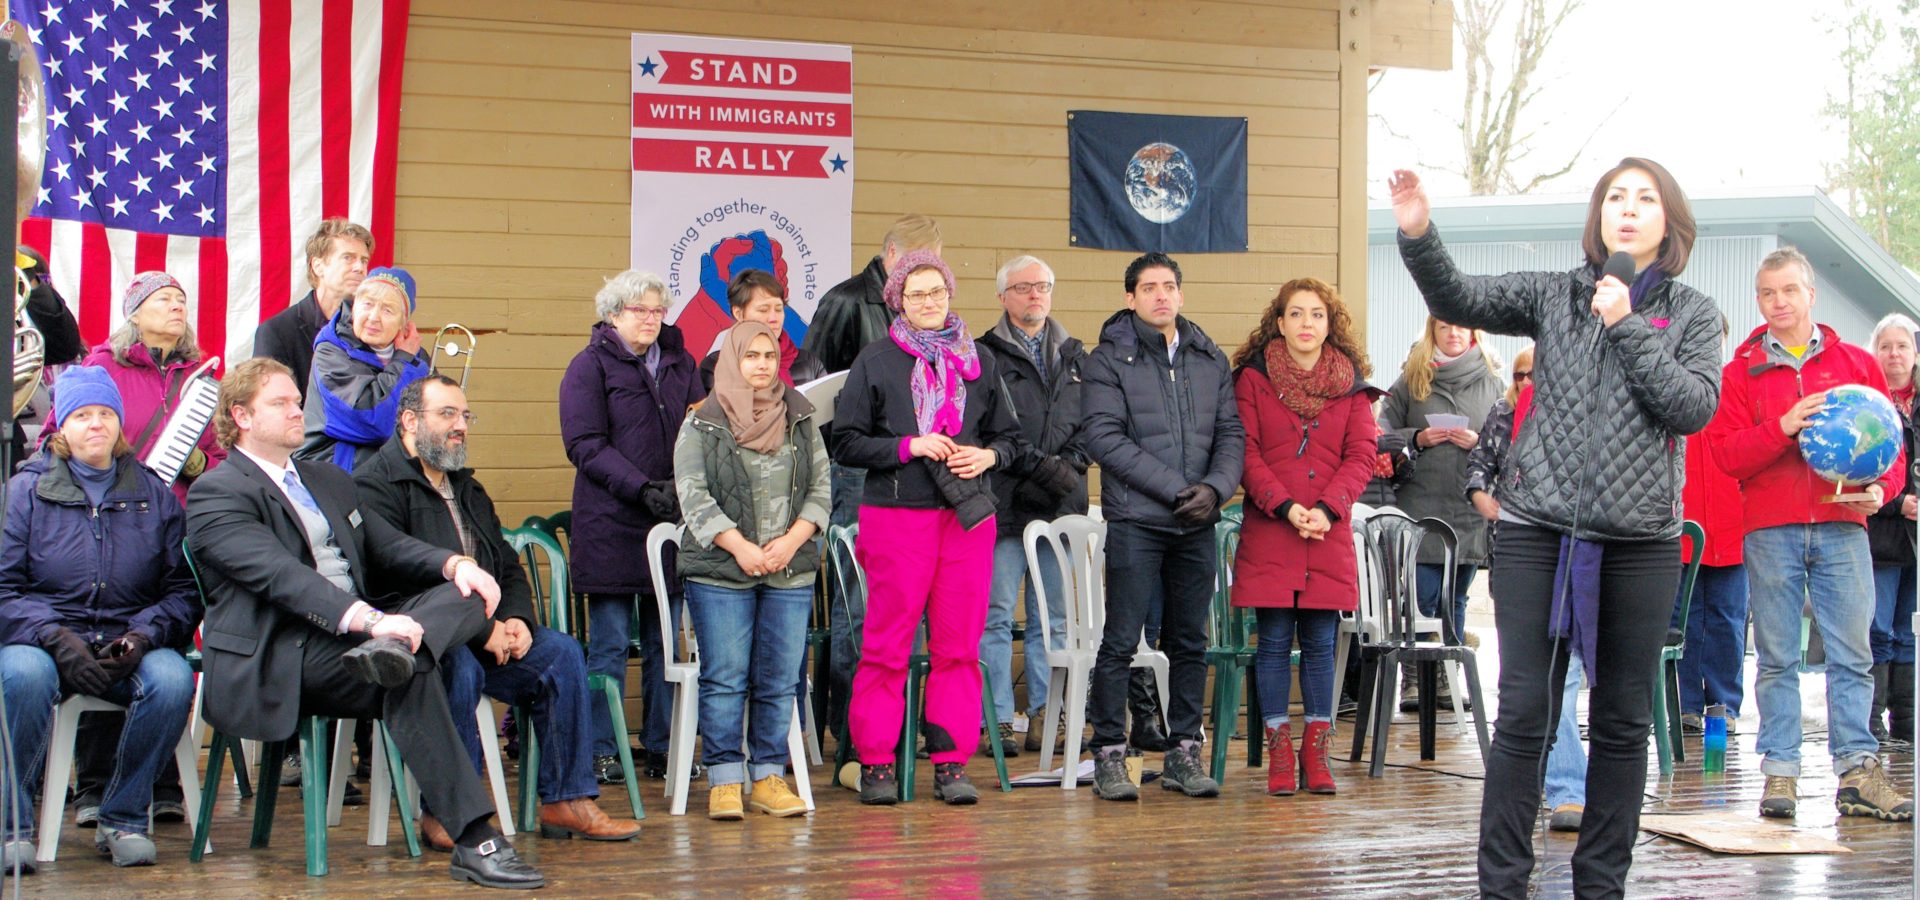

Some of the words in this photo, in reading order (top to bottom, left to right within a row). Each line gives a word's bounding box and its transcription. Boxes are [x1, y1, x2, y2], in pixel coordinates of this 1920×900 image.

[690, 58, 798, 86] STAND
[650, 103, 701, 121] WITH
[709, 106, 836, 127] IMMIGRANTS
[695, 146, 795, 171] RALLY
[669, 226, 700, 297] standing
[696, 198, 767, 228] together
[769, 210, 811, 260] against
[804, 262, 819, 301] hate
